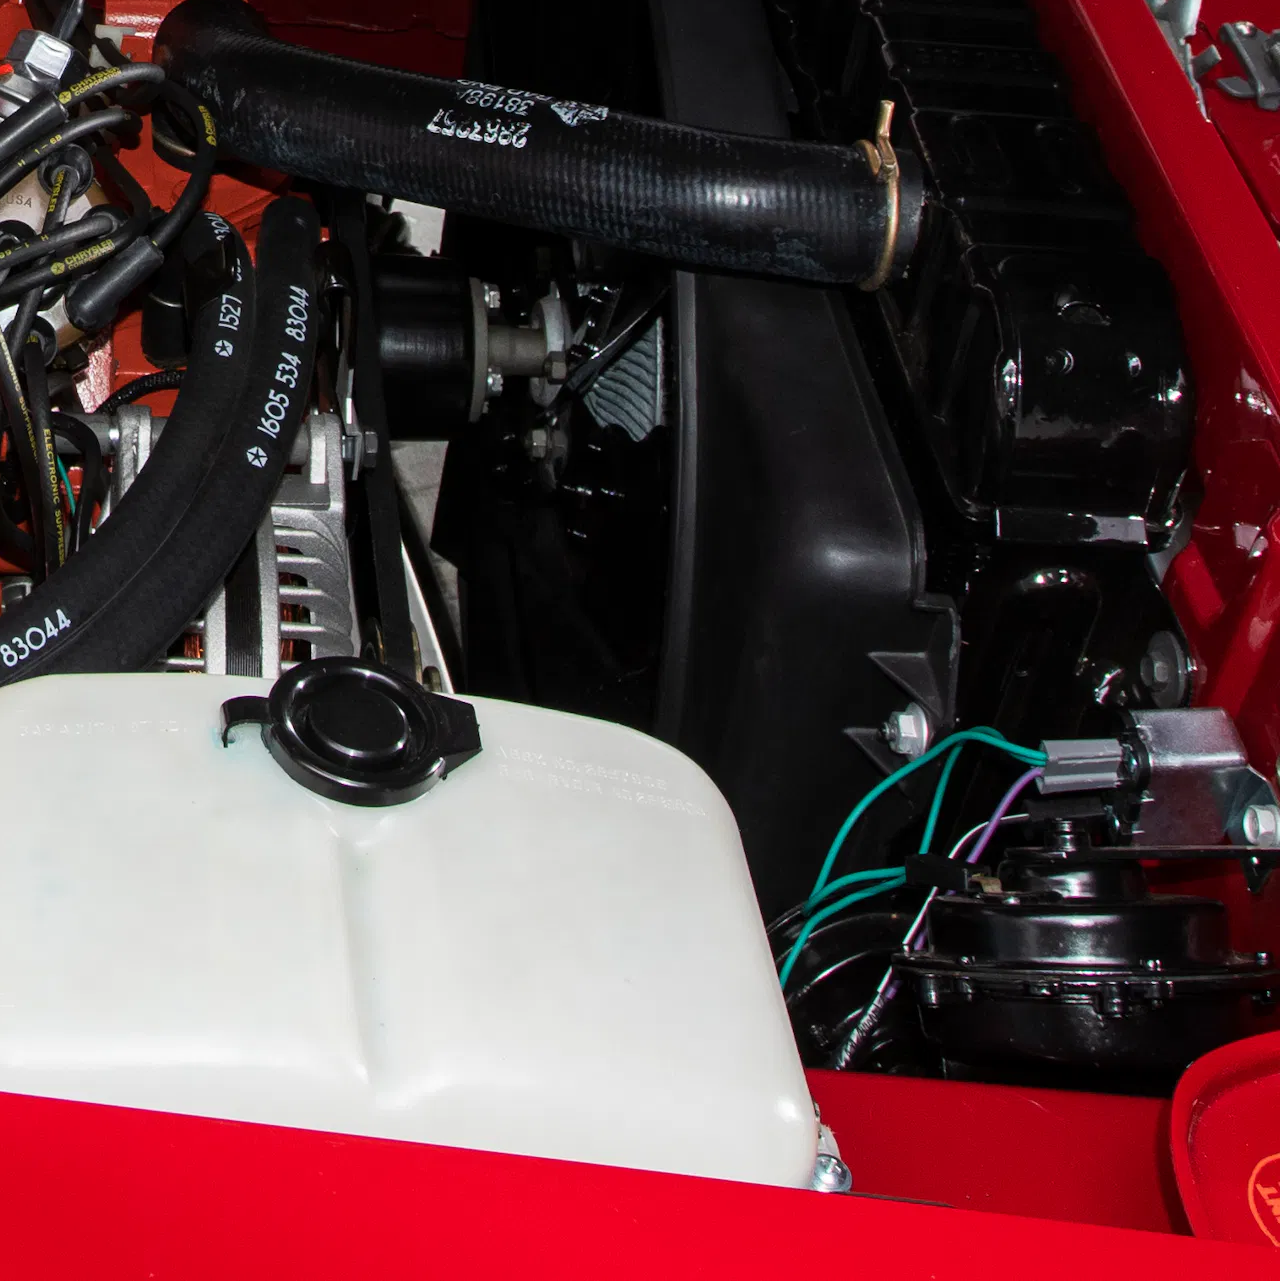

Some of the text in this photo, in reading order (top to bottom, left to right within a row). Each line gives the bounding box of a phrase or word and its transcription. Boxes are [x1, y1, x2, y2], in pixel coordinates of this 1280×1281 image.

[70, 66, 121, 93] CHRYSLER
[64, 238, 114, 265] CHRYSLER
[218, 294, 243, 331] 1527
[257, 284, 310, 439] 1605 534 83044
[42, 428, 60, 505] ELECTRONIC
[0, 608, 72, 669] 83044
